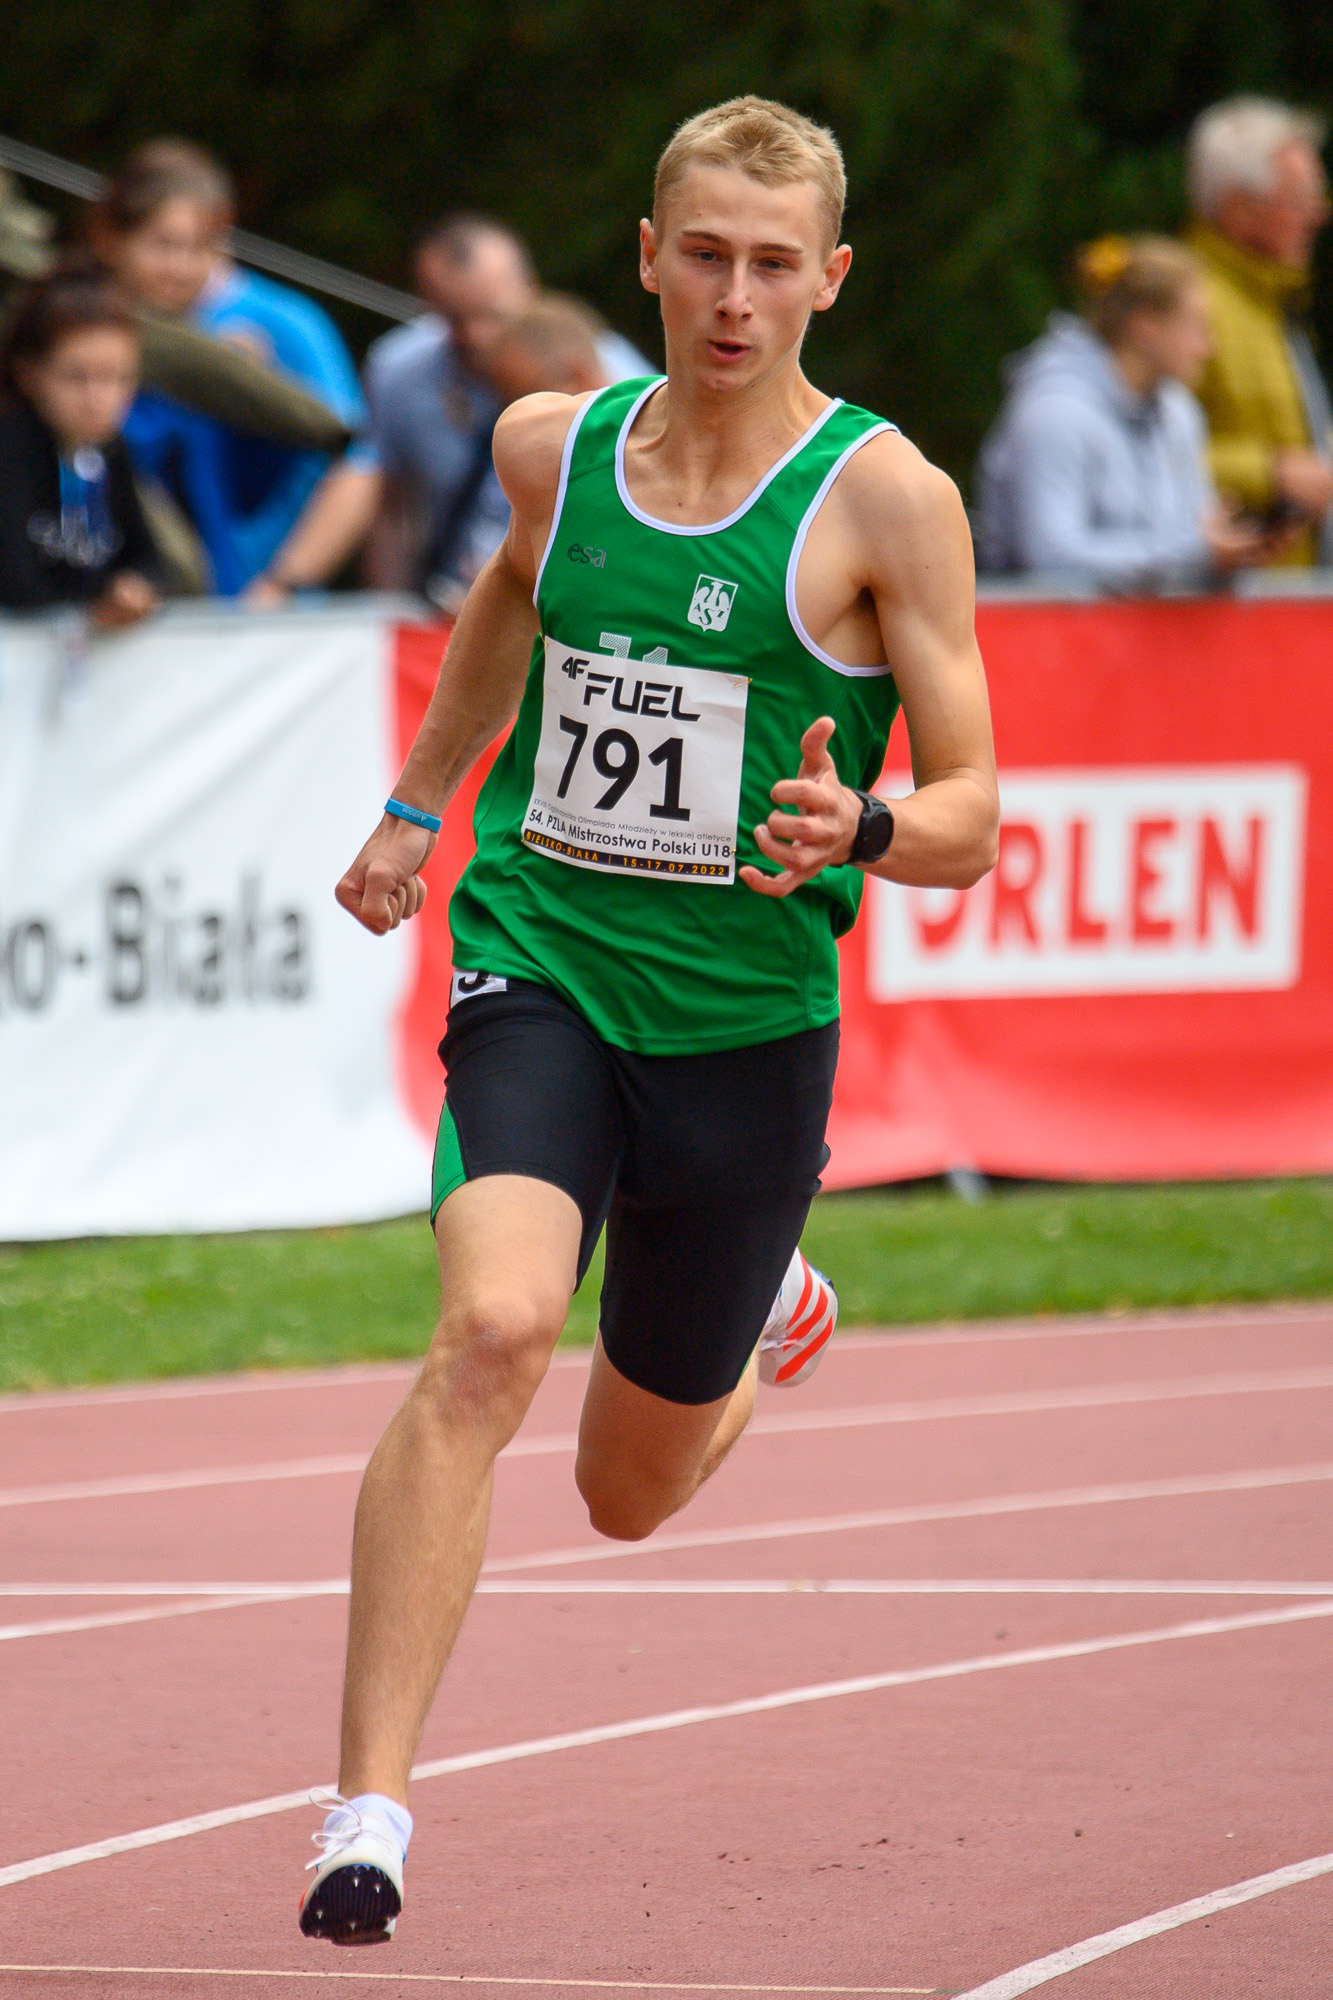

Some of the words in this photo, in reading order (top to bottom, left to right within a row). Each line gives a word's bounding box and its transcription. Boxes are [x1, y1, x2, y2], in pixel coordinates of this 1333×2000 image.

[567, 543, 607, 568] esa
[561, 656, 590, 680] 4F
[583, 671, 701, 722] FUEL
[557, 714, 691, 822] 791
[529, 808, 543, 826] 54.
[546, 814, 567, 835] PZLA
[568, 823, 647, 850] Mistrzostwa
[652, 838, 697, 856] Polski
[702, 843, 731, 858] U18
[578, 815, 616, 830] Olimpiada
[618, 823, 658, 837] Młodzieży
[669, 830, 695, 840] lekkiej
[697, 832, 732, 843] atletyce
[526, 831, 599, 862] BIELSKO-BIAŁA
[623, 857, 725, 876] 15-17.07.2022
